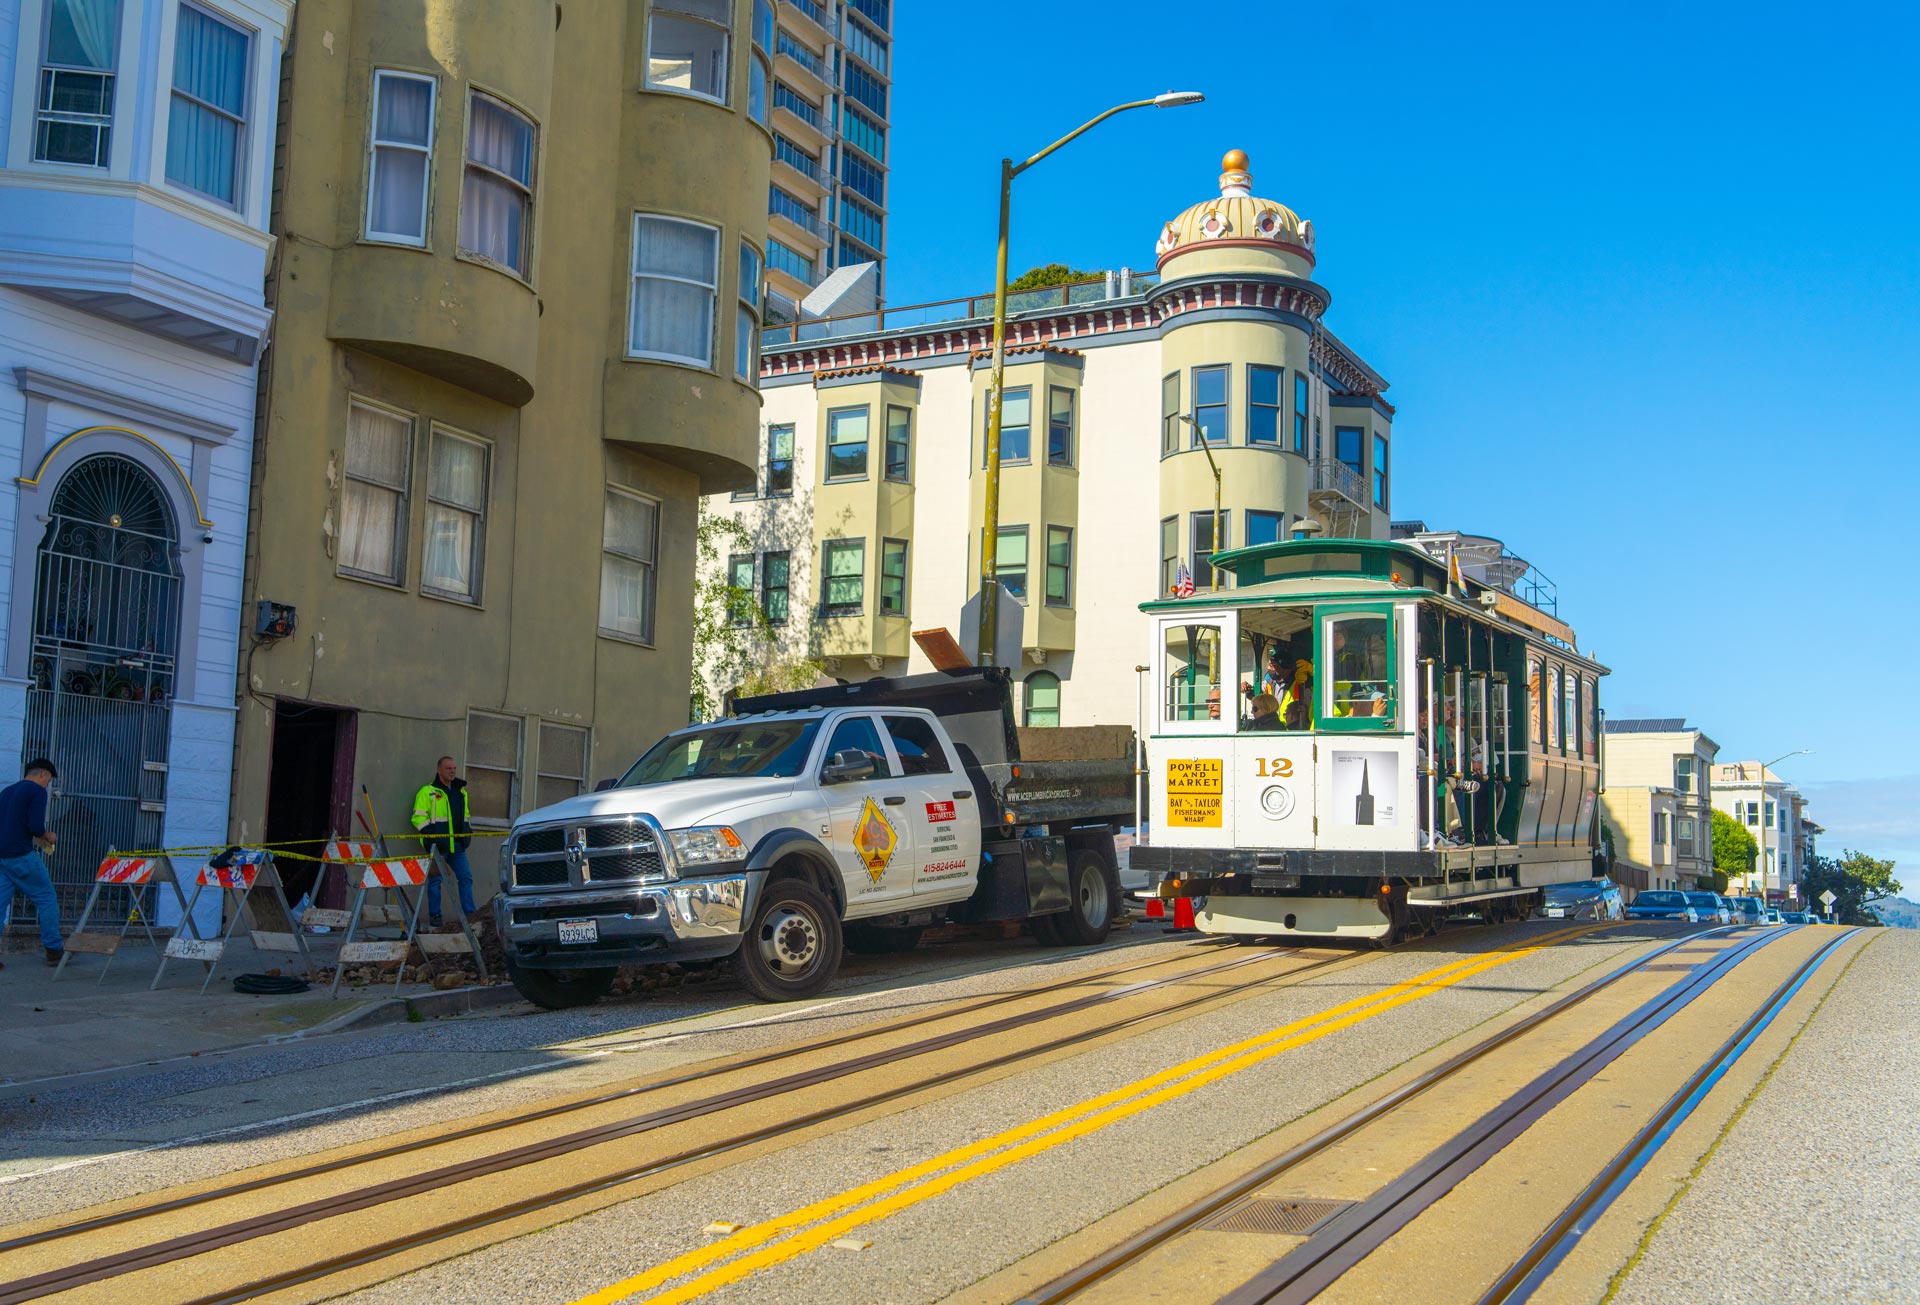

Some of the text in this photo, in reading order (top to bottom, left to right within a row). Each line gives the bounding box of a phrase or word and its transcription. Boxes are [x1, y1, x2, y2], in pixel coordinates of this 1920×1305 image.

[1170, 763, 1218, 771] POWELL
[1255, 757, 1293, 778] 12
[1168, 778, 1219, 787] MARKET
[933, 803, 948, 811] FREE
[1170, 798, 1183, 807] BAY
[1194, 798, 1220, 807] TAYLOR
[928, 811, 956, 821] ESTIMATES
[862, 820, 890, 845] ACE
[868, 860, 885, 868] ROOTER
[923, 859, 966, 873] 415-824-6444
[560, 928, 596, 941] 39394C3
